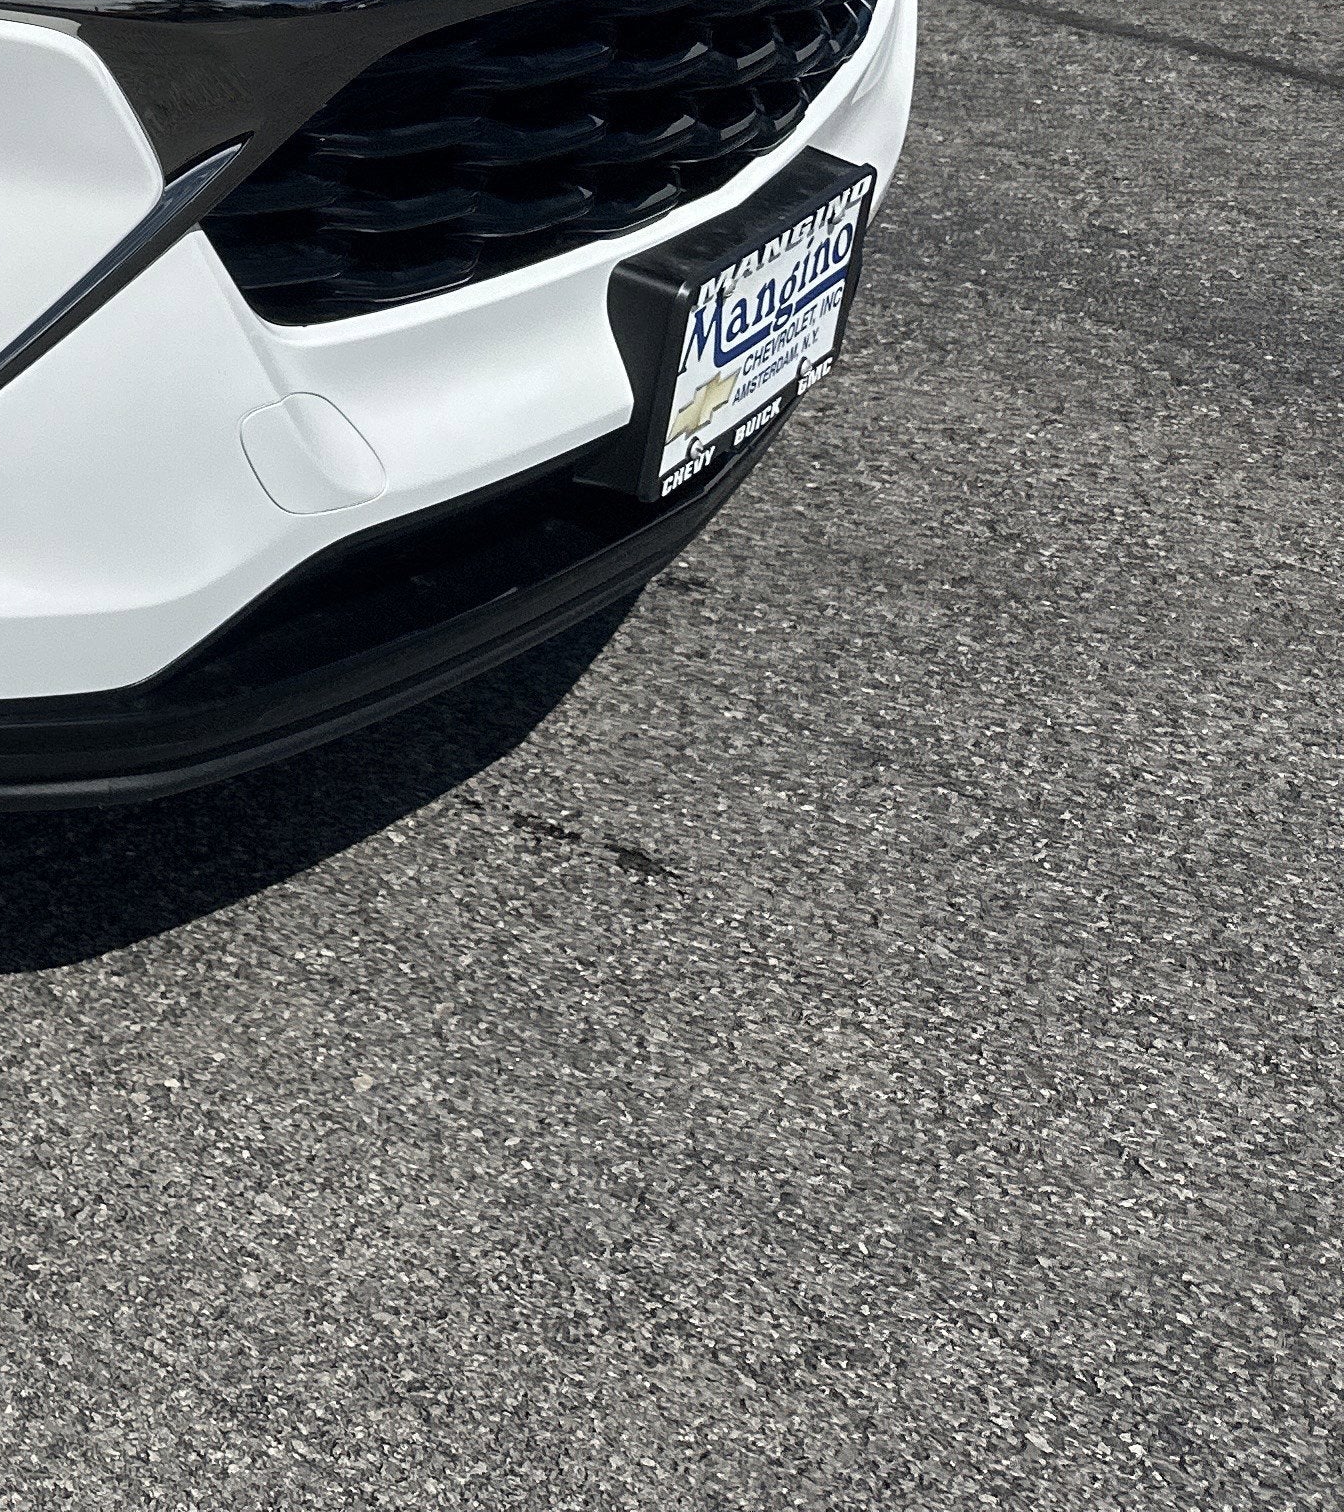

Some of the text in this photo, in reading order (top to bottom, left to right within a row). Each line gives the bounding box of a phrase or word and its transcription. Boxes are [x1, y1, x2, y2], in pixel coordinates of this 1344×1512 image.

[678, 222, 854, 373] Mangino
[695, 174, 873, 308] MANGINO
[742, 303, 818, 376] CHEVROLET,
[662, 356, 834, 498] CHEVY BUICK GMC
